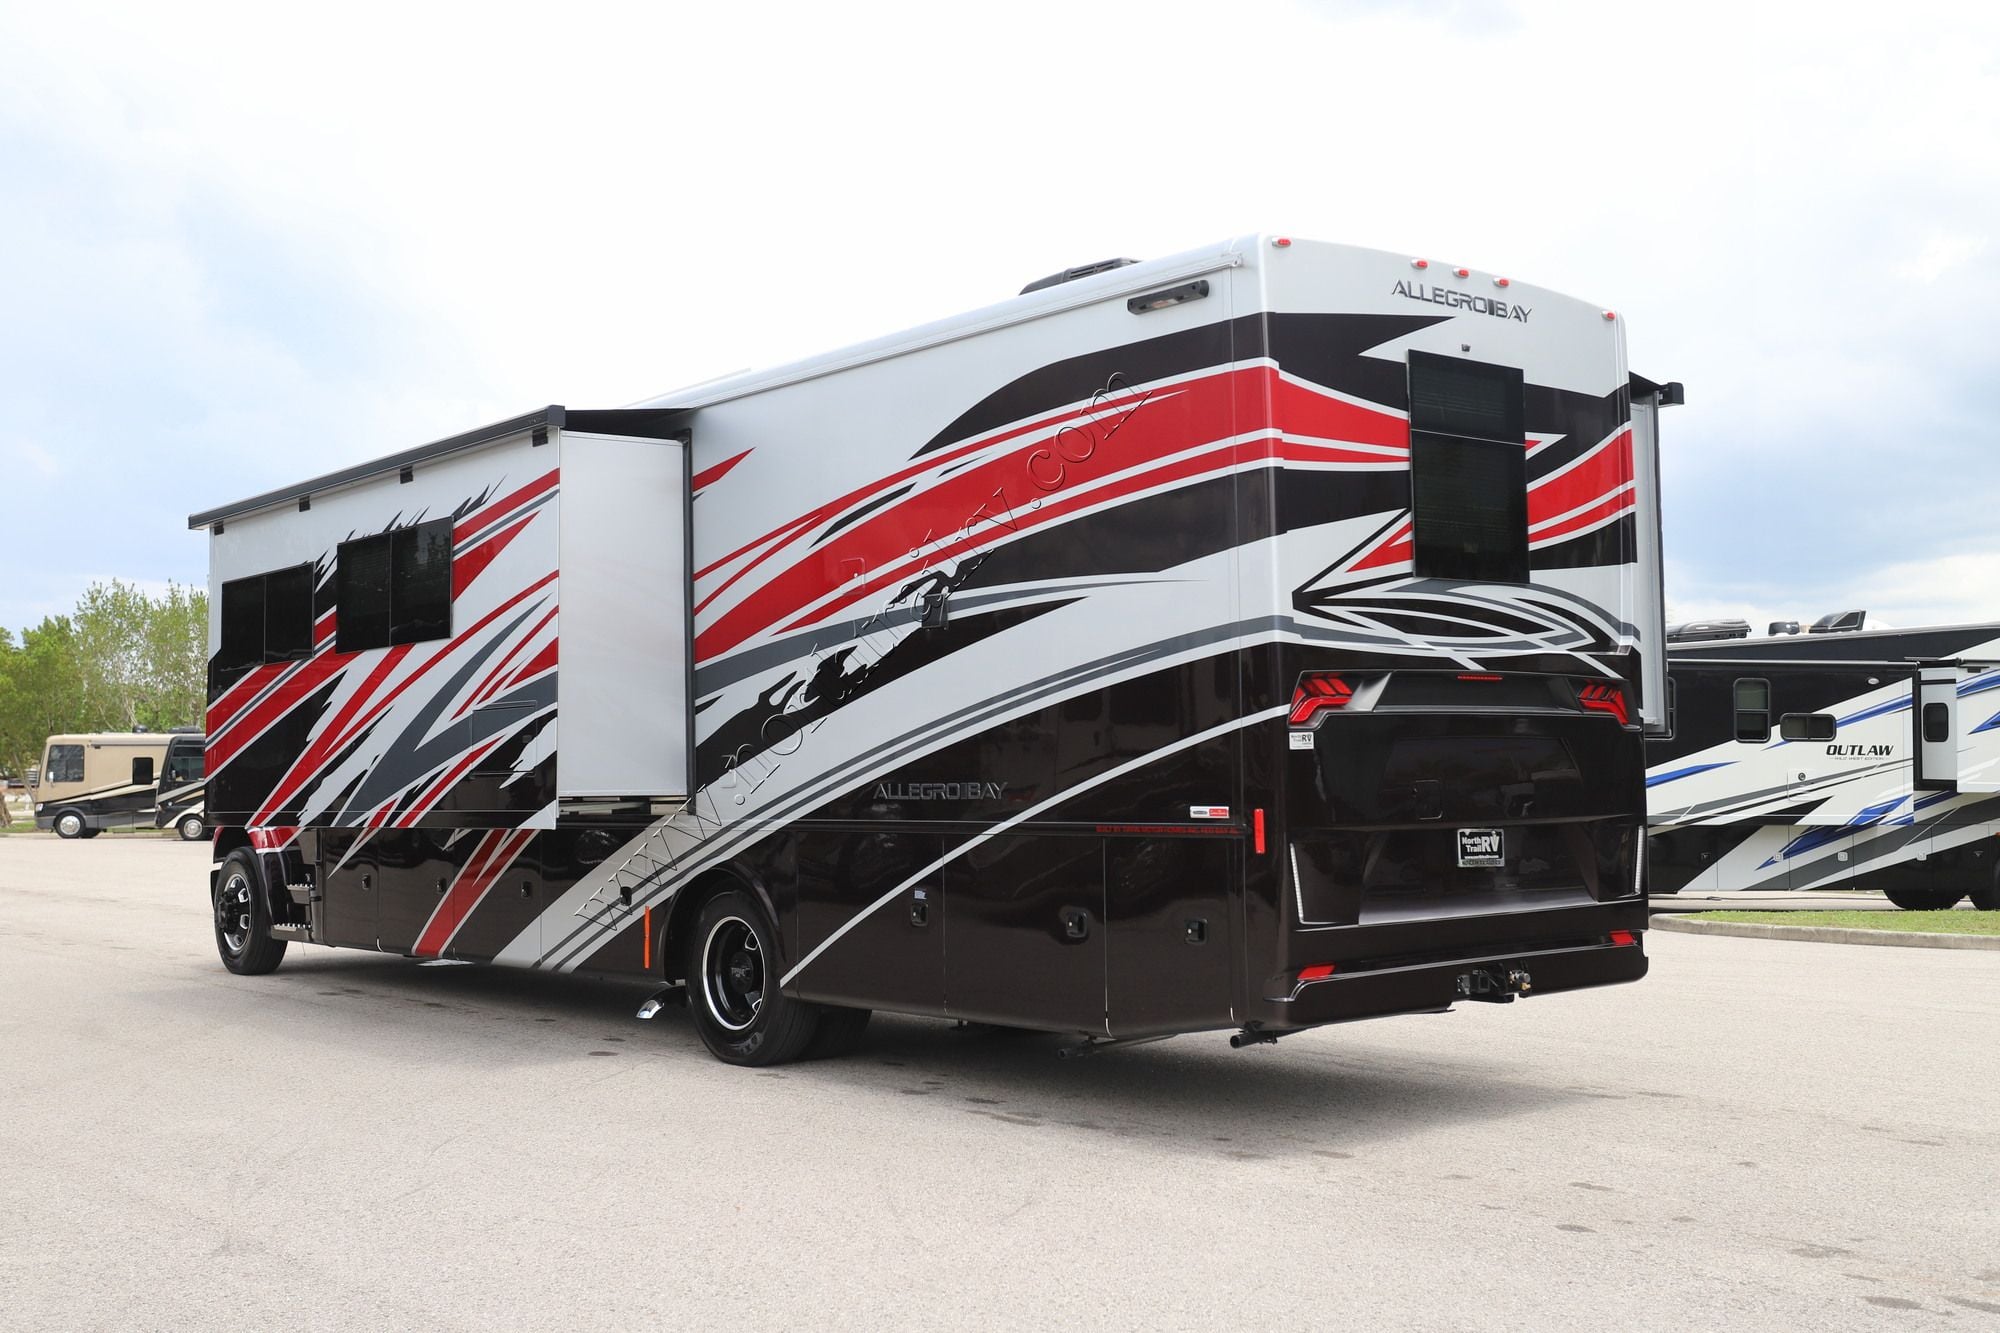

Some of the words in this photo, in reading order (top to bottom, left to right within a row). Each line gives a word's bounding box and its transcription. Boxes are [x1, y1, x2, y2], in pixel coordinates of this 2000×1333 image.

[1392, 279, 1487, 314] ALLEGRO
[1495, 301, 1532, 323] BAY
[1826, 744, 1894, 756] OUTLAW
[873, 783, 960, 800] ALLEGRO
[967, 782, 1008, 800] BAY
[1462, 836, 1481, 845] North
[1481, 836, 1499, 852] RV
